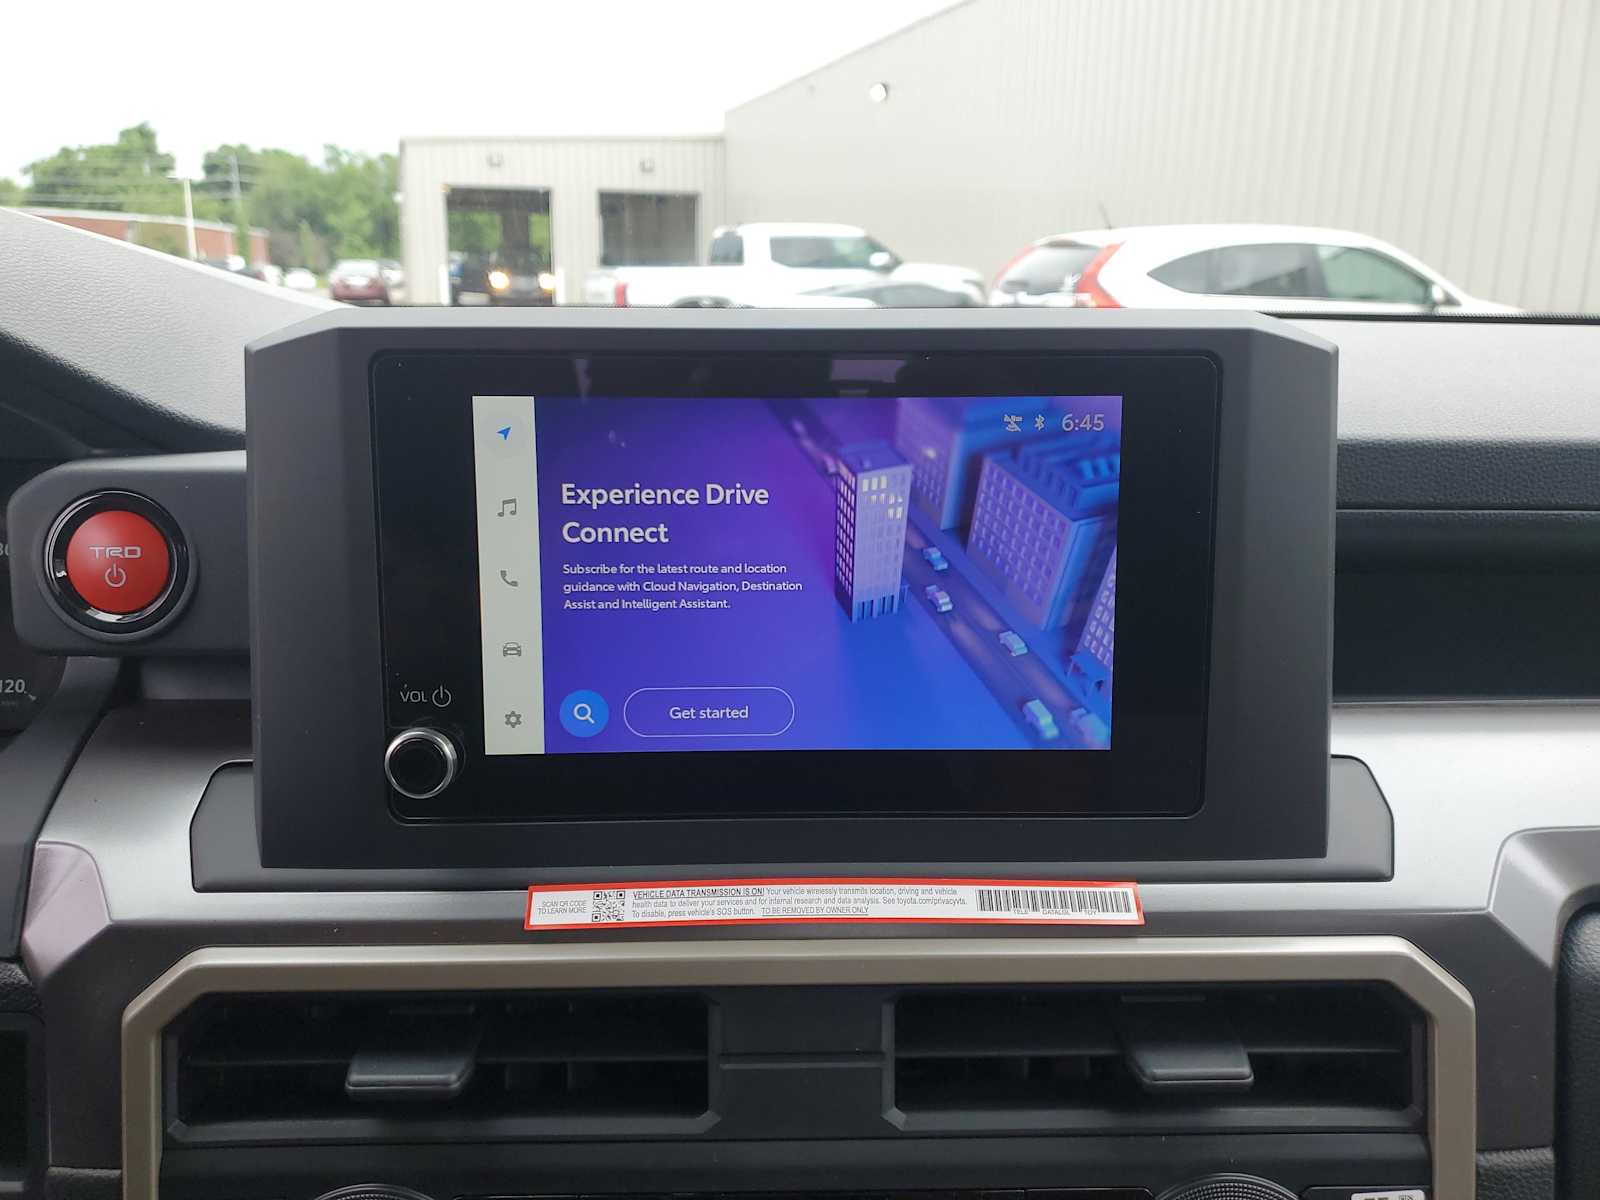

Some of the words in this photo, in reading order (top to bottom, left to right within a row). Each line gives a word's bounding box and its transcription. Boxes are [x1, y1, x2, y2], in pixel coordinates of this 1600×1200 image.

[1062, 413, 1105, 432] 6:45
[561, 483, 699, 509] Experience
[706, 483, 769, 505] Drive
[562, 522, 669, 543] Connect
[89, 546, 142, 559] TRD
[563, 564, 617, 574] Subscribe
[619, 563, 635, 574] for
[637, 563, 655, 574] the
[657, 563, 688, 574] latest
[690, 564, 719, 574] route
[721, 563, 742, 573] and
[744, 563, 787, 573] location
[563, 581, 615, 594] guidance
[617, 581, 640, 591] with
[643, 581, 676, 591] Cloud
[679, 581, 740, 593] Navigation,
[742, 581, 803, 591] Destination
[564, 599, 596, 609] Assist
[598, 599, 620, 609] and
[622, 599, 678, 611] Intelligent
[679, 598, 731, 609] Assistant.
[400, 690, 428, 703] VOL
[669, 706, 697, 719] Get
[699, 705, 749, 719] started
[632, 890, 665, 899] VEHICLE
[665, 889, 685, 898] DATA
[687, 887, 741, 897] TRANSMISSION
[767, 887, 781, 895] Your
[782, 887, 805, 895] vehicle
[806, 887, 838, 896] wirelessly
[839, 887, 868, 895] transmits
[897, 887, 919, 896] driving
[920, 887, 933, 895] and
[935, 887, 957, 895] vehicle
[632, 900, 651, 908] health
[653, 899, 668, 908] data
[678, 899, 699, 907] deliver
[701, 899, 715, 908] your
[716, 898, 744, 907] services
[745, 897, 757, 905] and
[758, 897, 768, 905] for
[769, 896, 793, 905] internal
[794, 896, 823, 904] research
[823, 896, 836, 904] and
[837, 896, 849, 904] data
[882, 896, 896, 904] See
[667, 909, 686, 918] press
[687, 908, 715, 917] vehicle's
[716, 907, 732, 915] SOS
[825, 906, 852, 914] OWNER
[852, 906, 869, 914] ONLY
